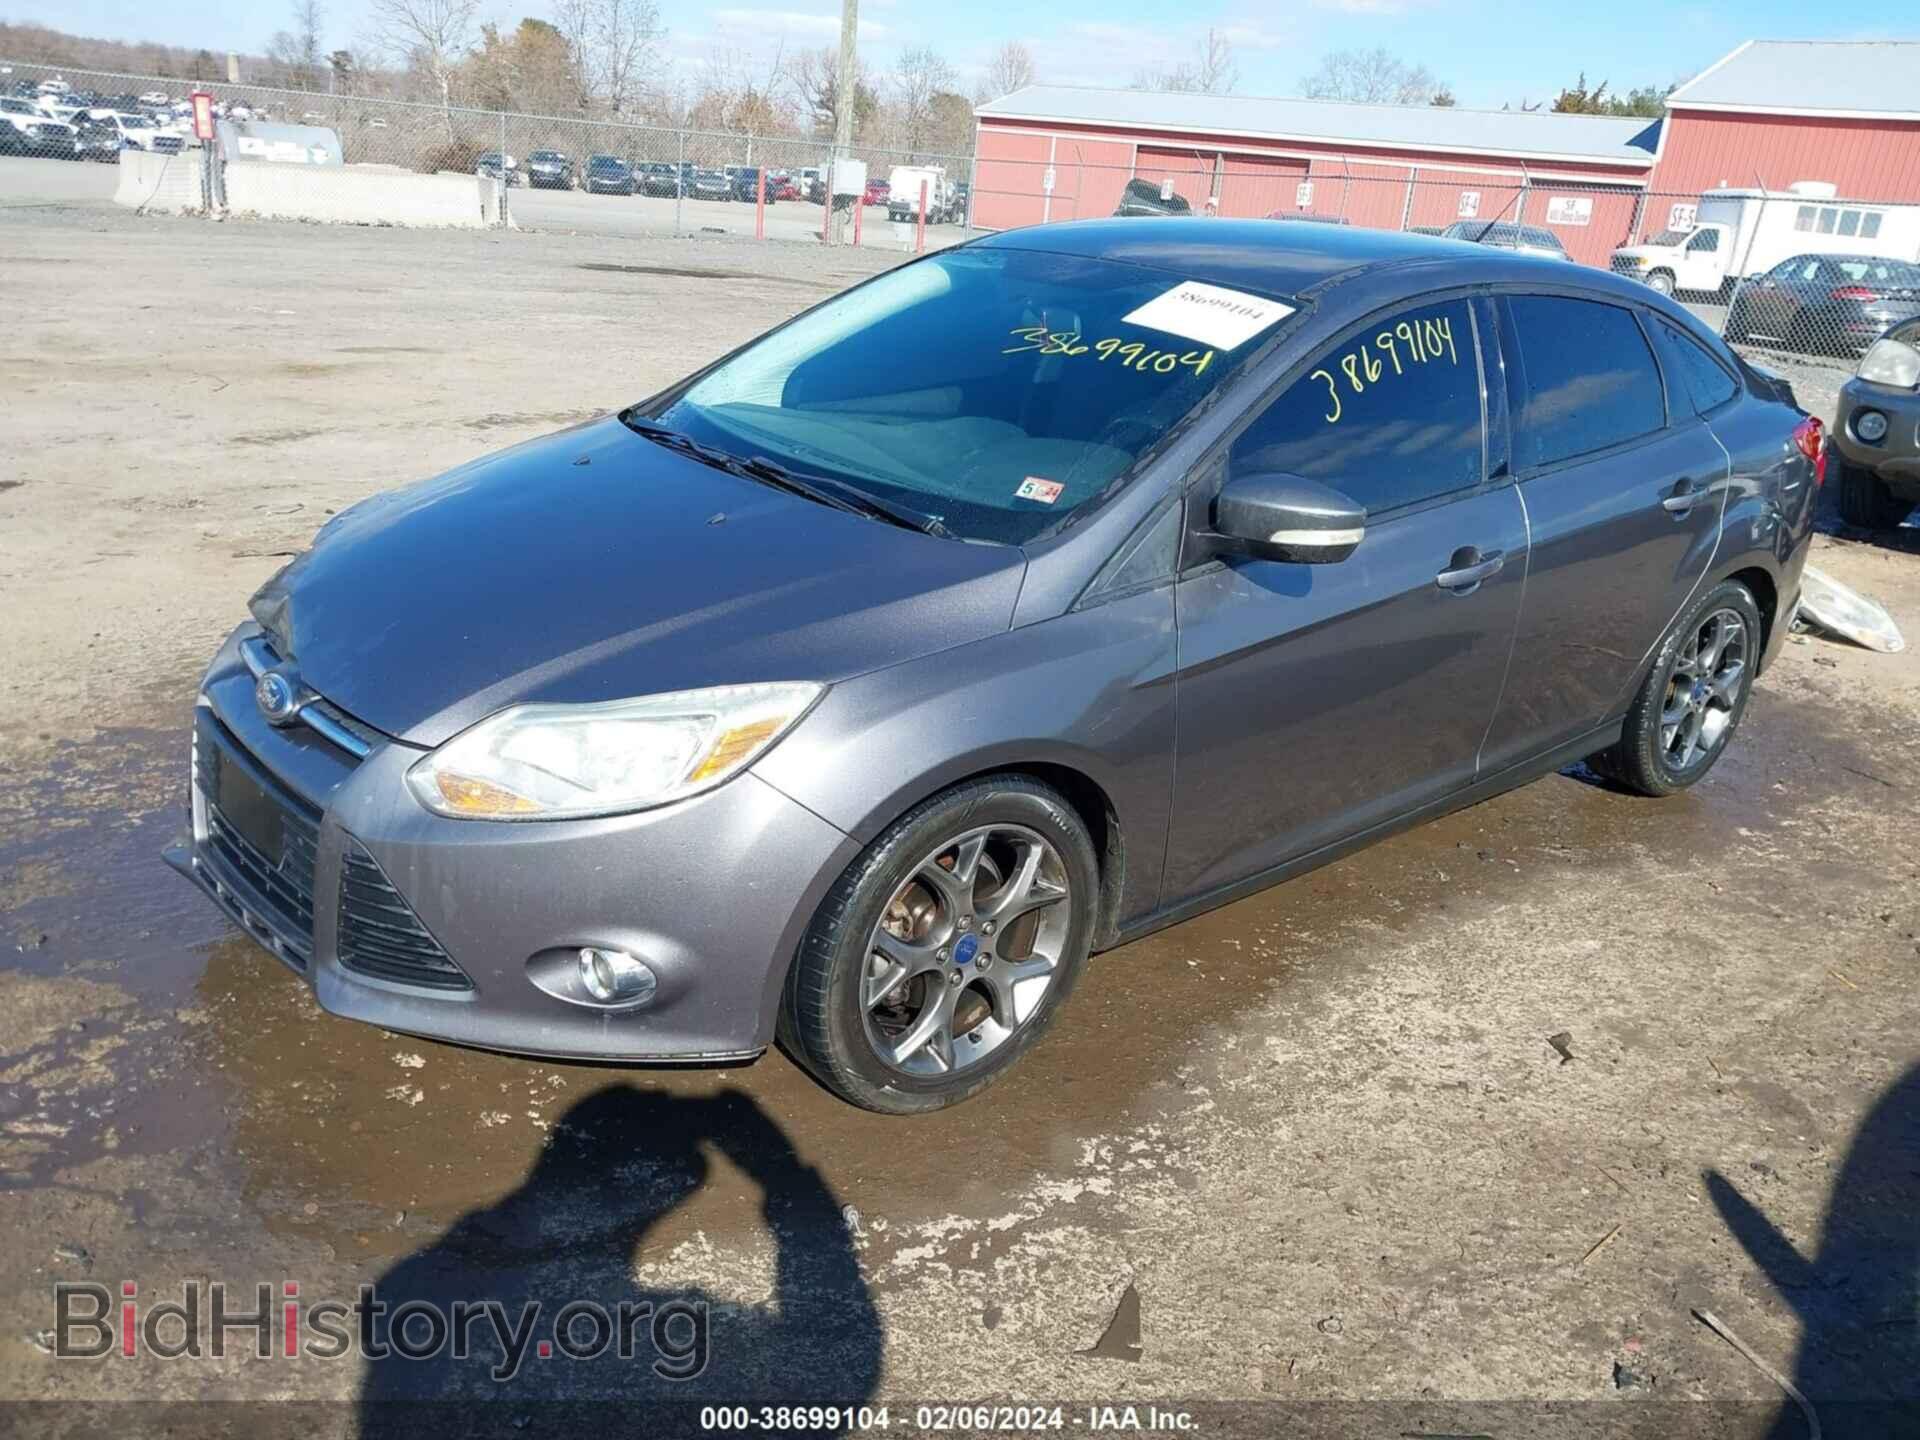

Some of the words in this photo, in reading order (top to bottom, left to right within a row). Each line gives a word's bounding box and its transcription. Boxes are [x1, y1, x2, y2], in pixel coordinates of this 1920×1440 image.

[1671, 207, 1695, 228] SF-5
[1180, 291, 1265, 320] 38699104
[1001, 327, 1215, 376] 38699104
[1310, 317, 1457, 423] 38699104
[1022, 482, 1036, 494] 5
